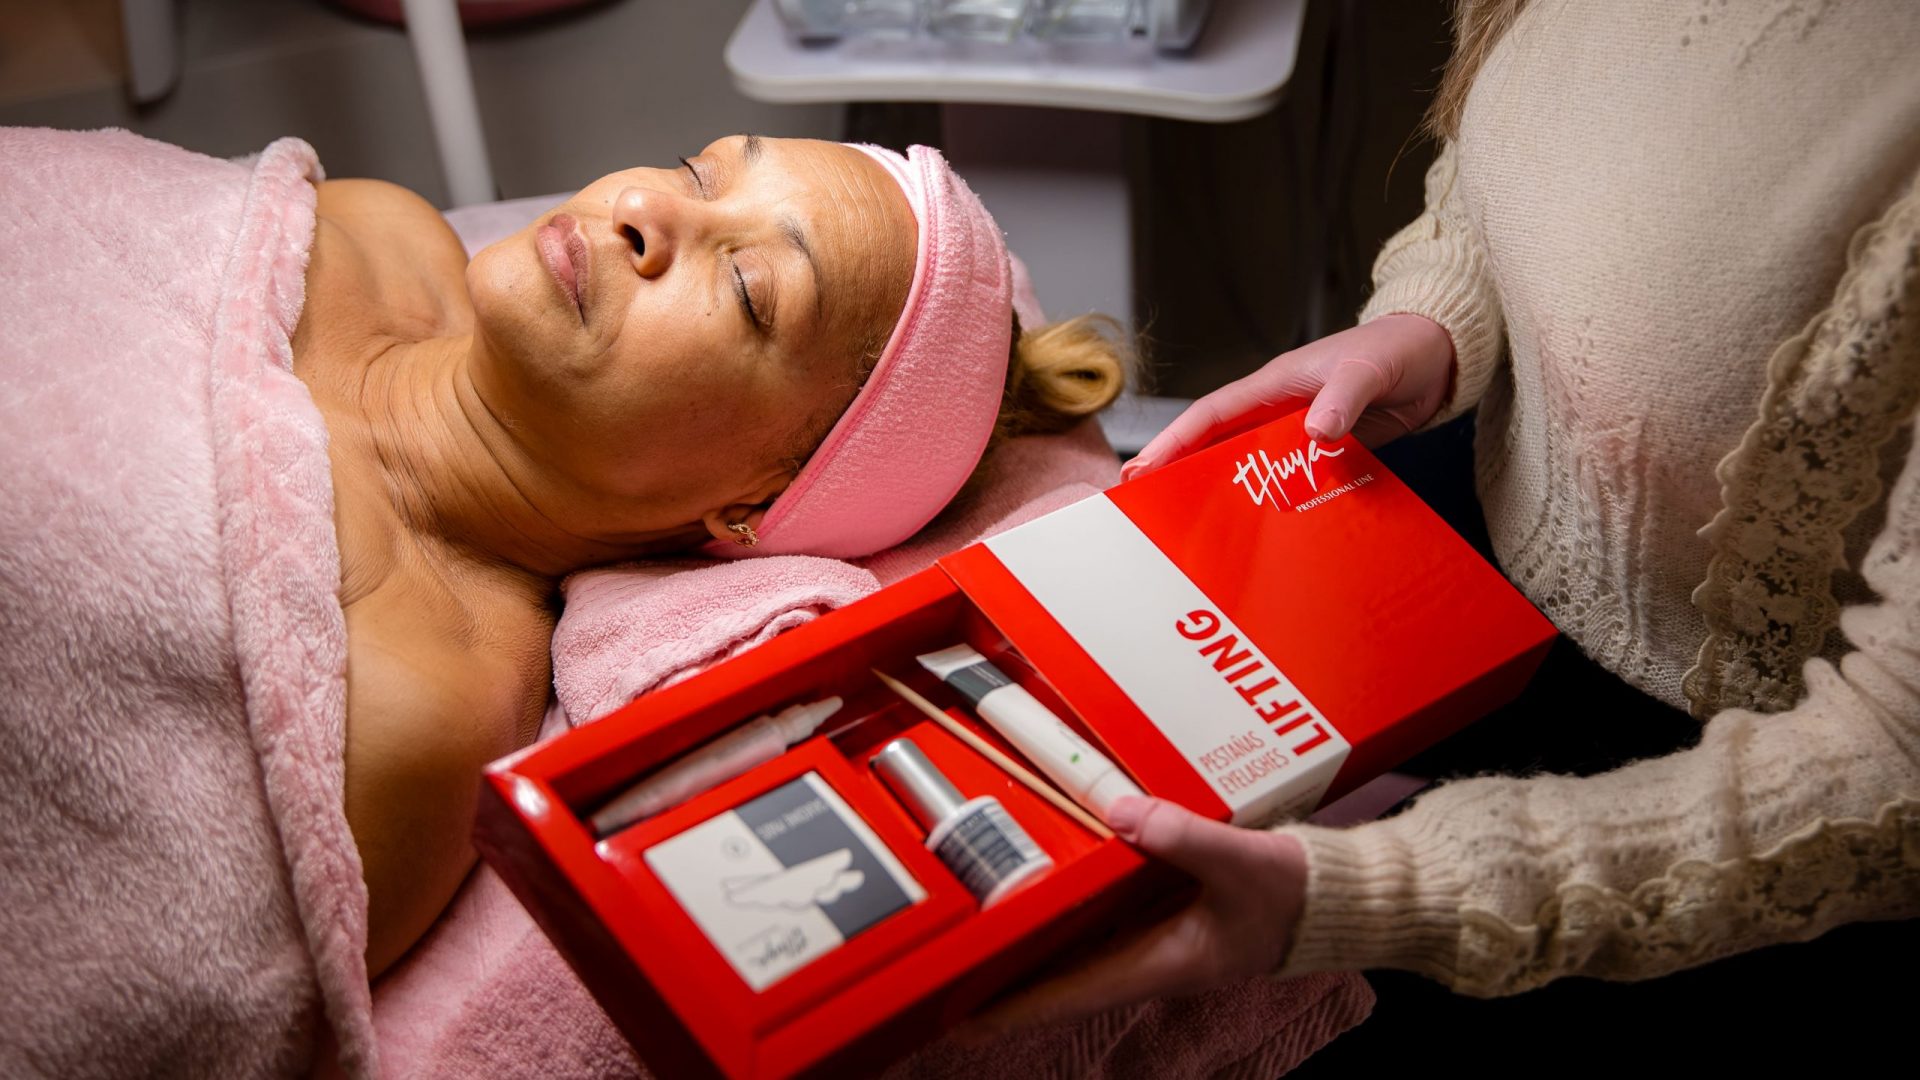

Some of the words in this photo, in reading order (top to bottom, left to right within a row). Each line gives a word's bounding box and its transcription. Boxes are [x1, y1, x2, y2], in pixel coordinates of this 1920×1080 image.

[1295, 482, 1355, 513] PROFESSIONAL
[1354, 473, 1375, 487] LINE
[1175, 609, 1332, 756] LIFTING
[1198, 730, 1265, 774] PESTAÑAS
[1217, 748, 1290, 795] EYELASHES
